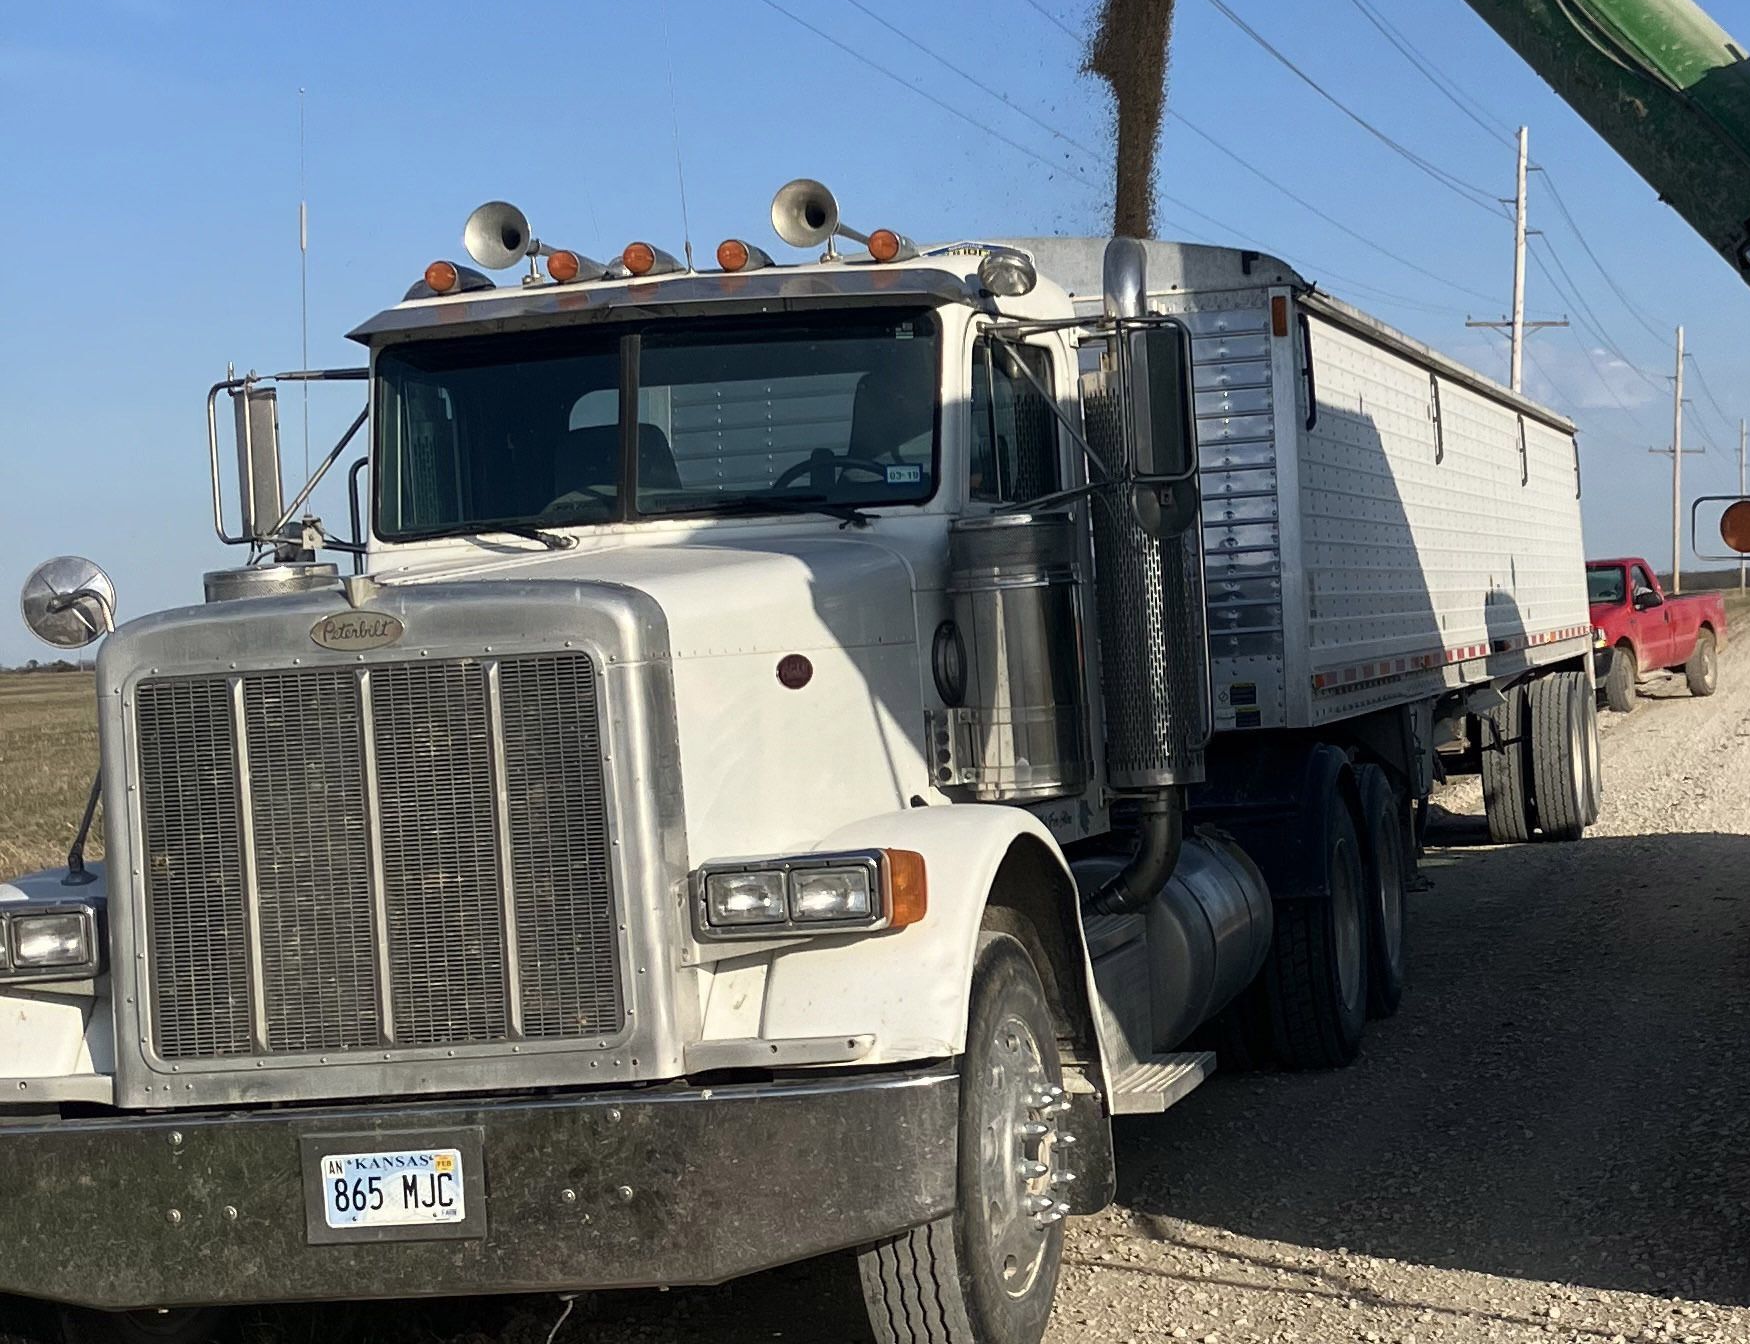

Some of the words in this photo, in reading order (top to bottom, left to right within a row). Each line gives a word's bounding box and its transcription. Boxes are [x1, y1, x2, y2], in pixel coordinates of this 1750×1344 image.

[323, 620, 394, 643] Peterbilt
[329, 1159, 344, 1175] AN
[355, 1154, 430, 1170] KANSAS
[334, 1176, 384, 1212] 865
[402, 1172, 454, 1209] MJC
